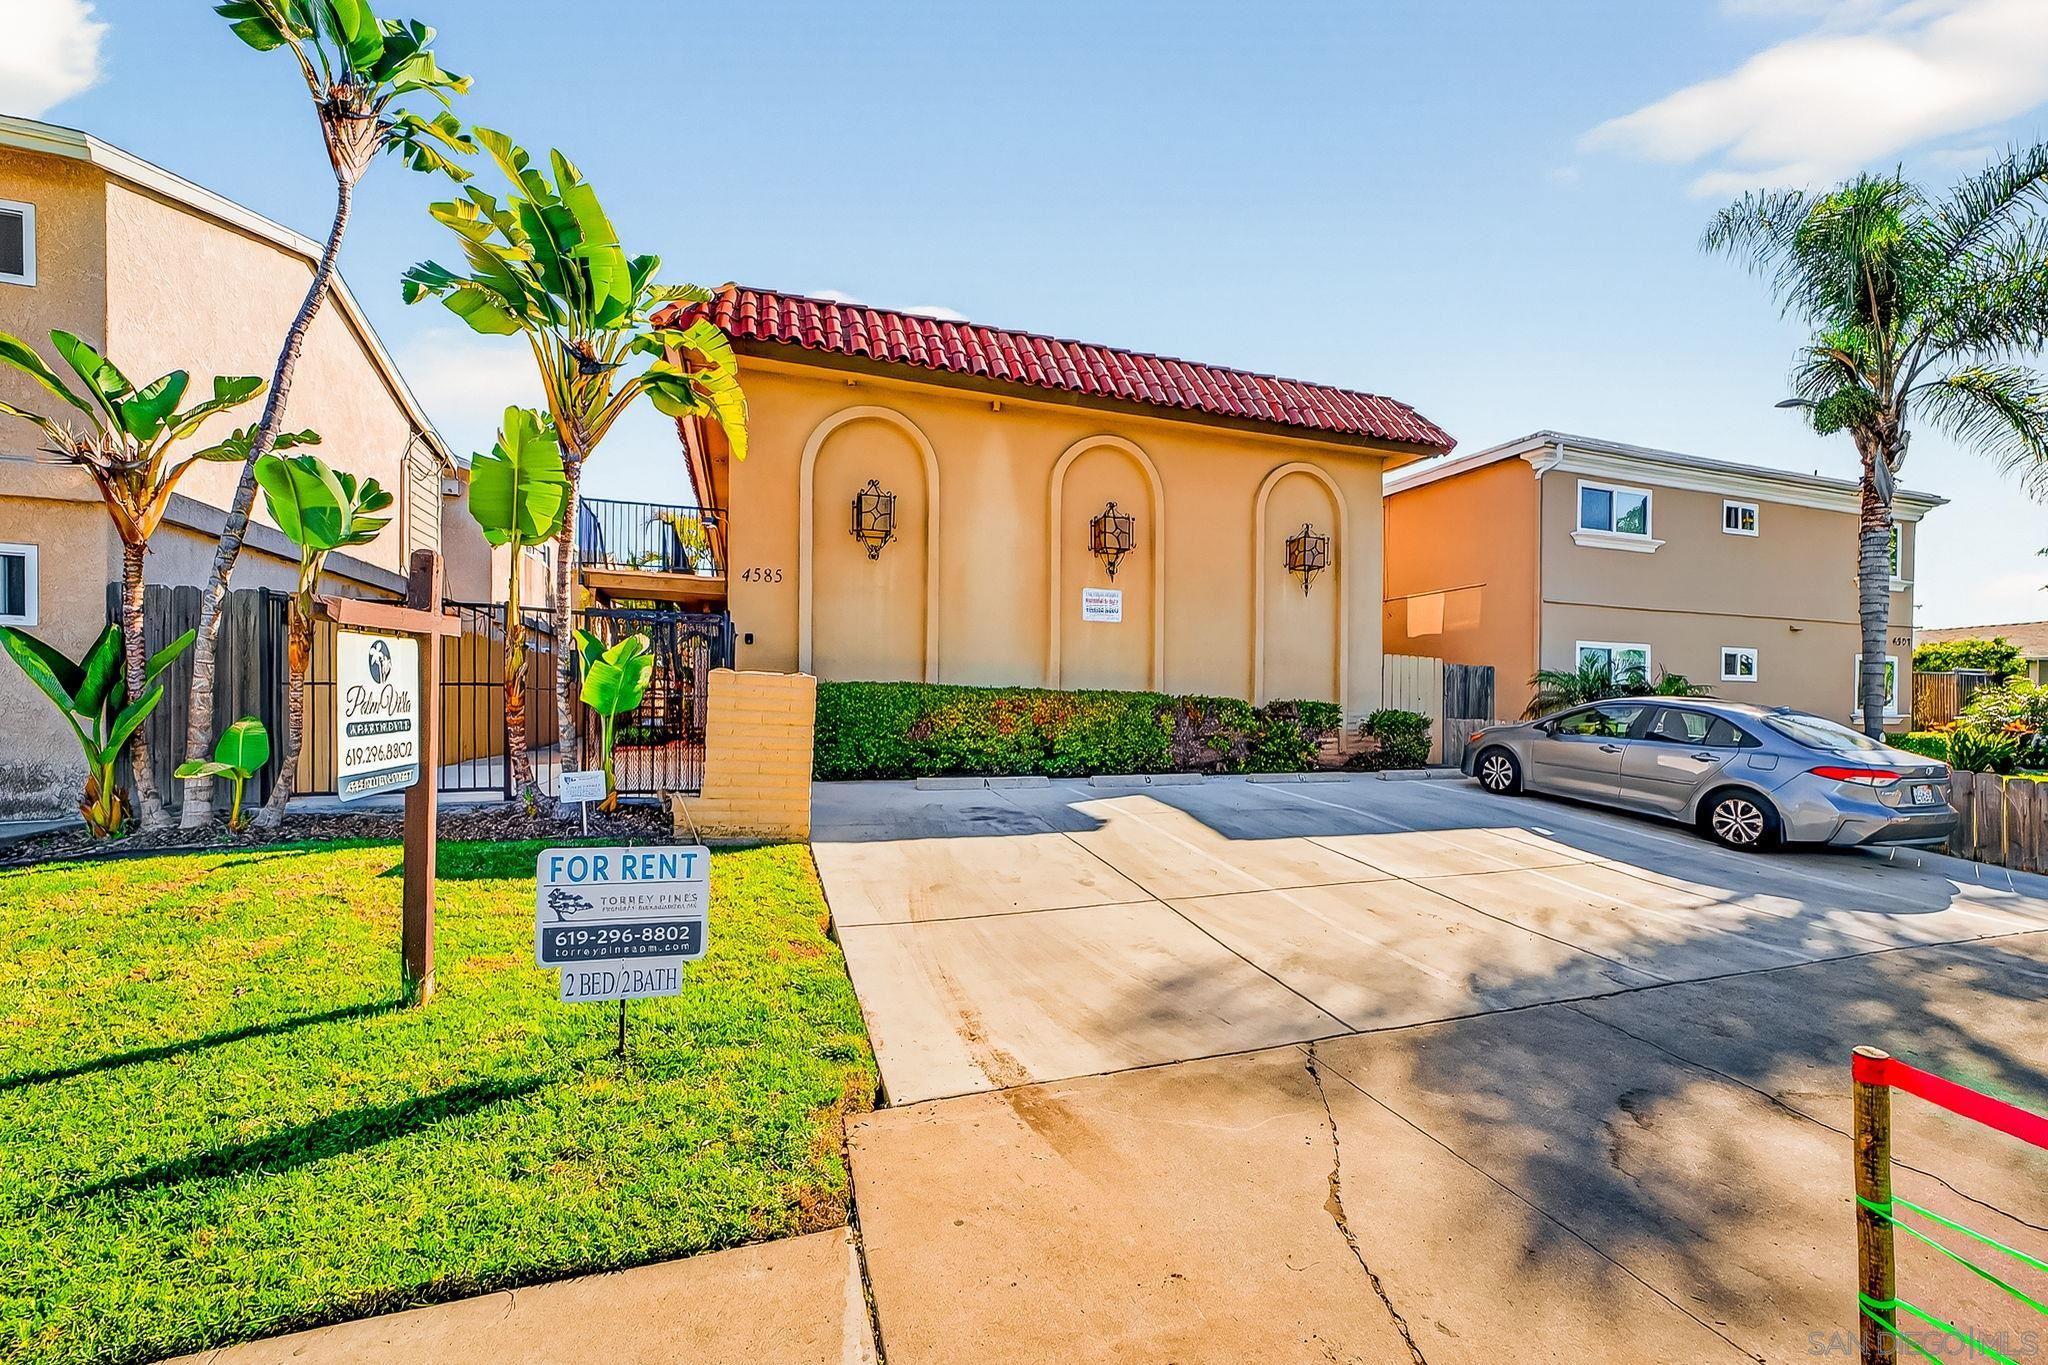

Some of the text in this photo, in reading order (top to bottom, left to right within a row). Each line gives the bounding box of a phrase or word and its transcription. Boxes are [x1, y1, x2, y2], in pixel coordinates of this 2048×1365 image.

[742, 567, 782, 583] 4585
[346, 683, 412, 718] Palm Villa
[550, 853, 698, 883] FOR RENT
[600, 893, 698, 908] TORREY PINES
[555, 926, 690, 947] 619-296-8802
[565, 973, 575, 997] 2
